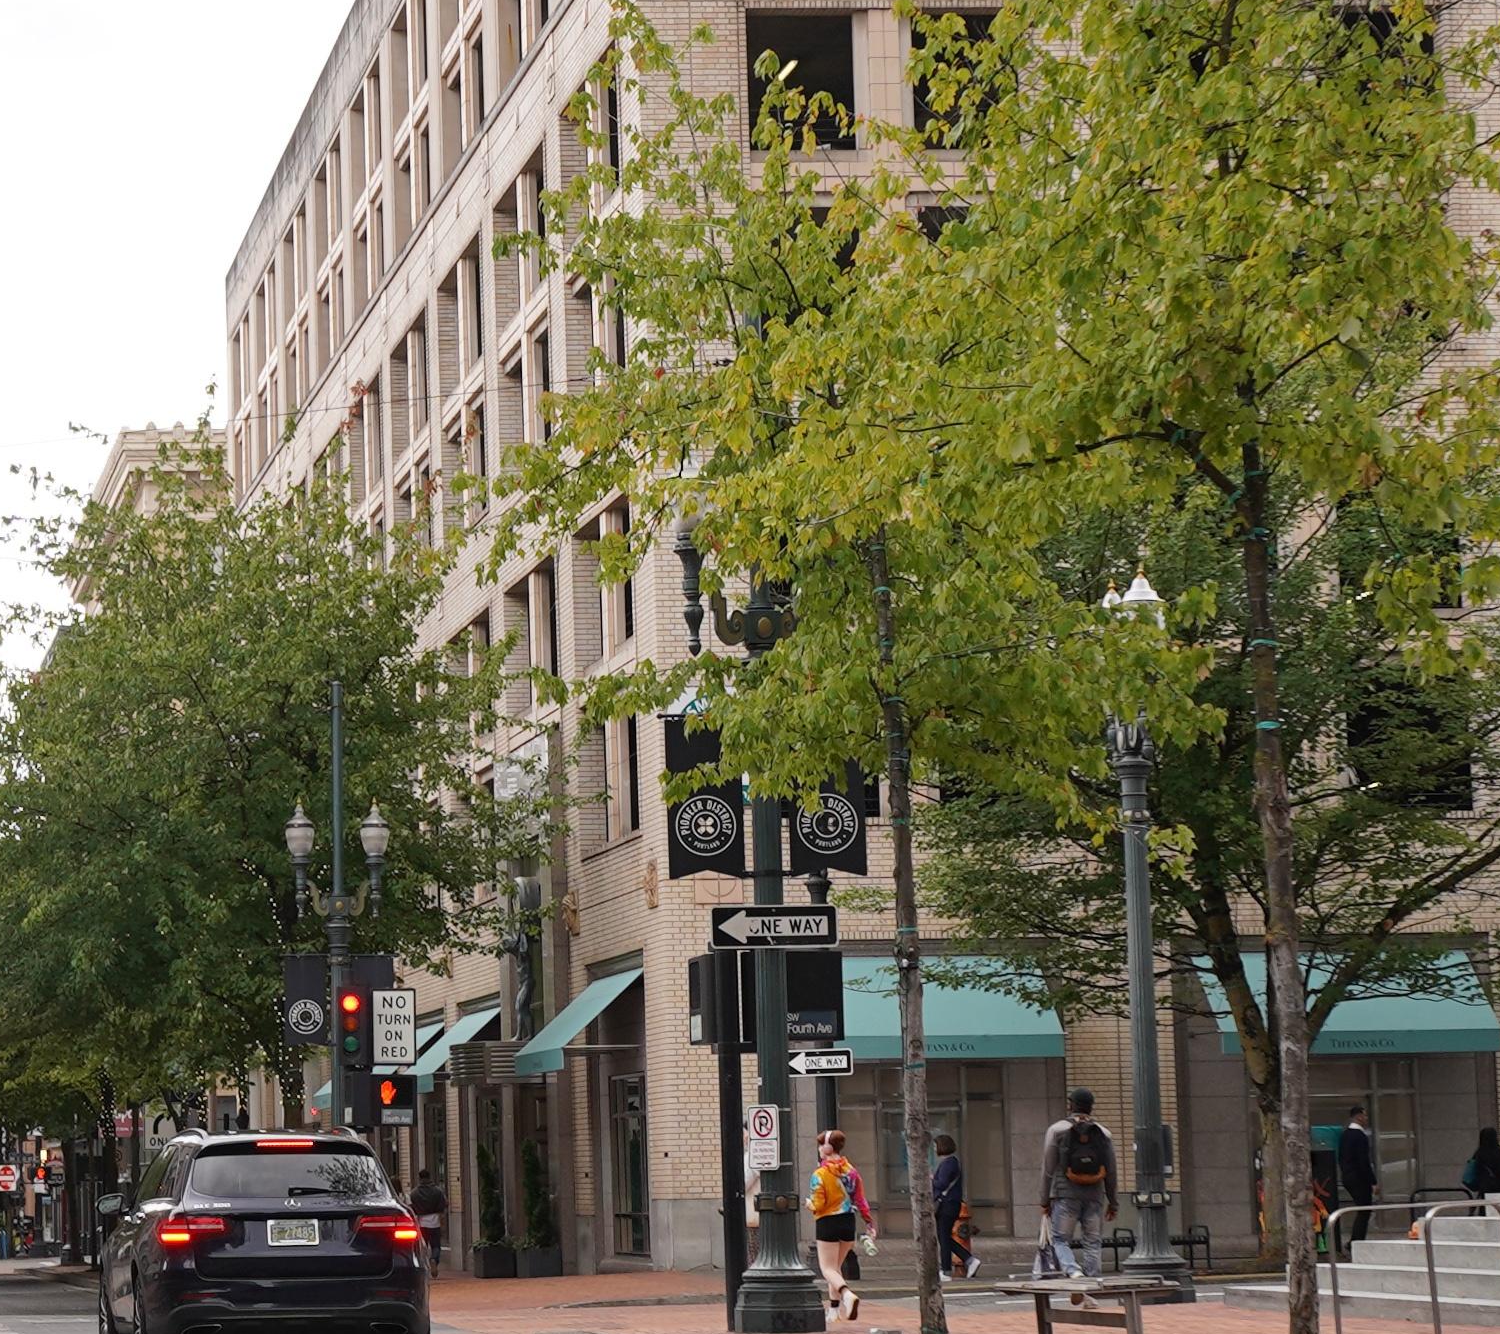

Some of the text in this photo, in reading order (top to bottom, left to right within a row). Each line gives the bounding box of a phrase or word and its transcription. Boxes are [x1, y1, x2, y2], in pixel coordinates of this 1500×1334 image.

[679, 799, 732, 836] PIONEER DISTRICT
[827, 797, 854, 833] DISTRICT
[789, 918, 823, 934] WAY
[382, 995, 407, 1009] NO
[377, 1013, 411, 1025] TURN
[786, 1012, 800, 1022] SW
[787, 1023, 833, 1034] Fourth Ave
[384, 1030, 403, 1041] ON
[381, 1046, 408, 1058] RED
[804, 1057, 846, 1068] ONE WAY
